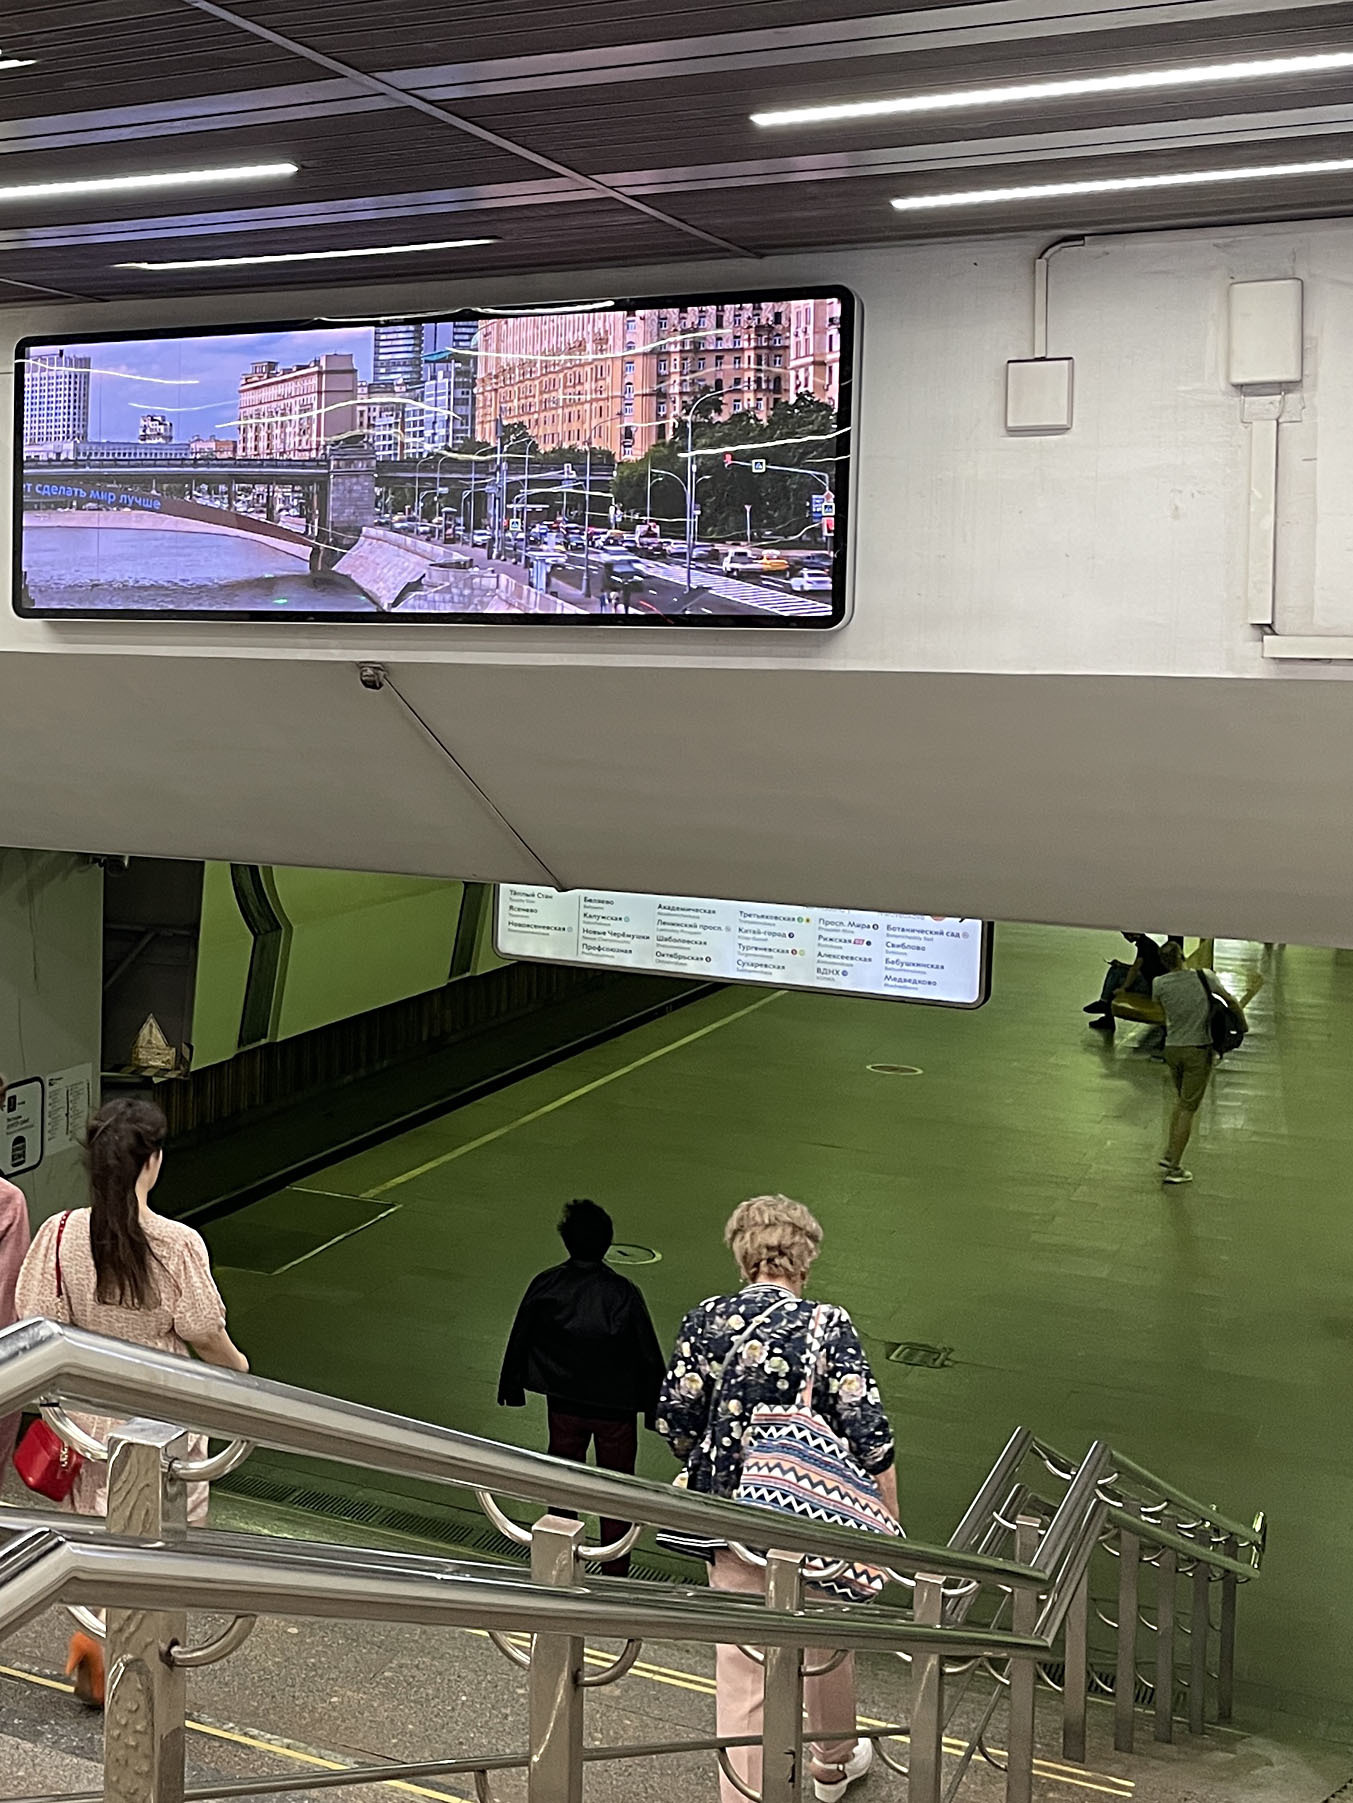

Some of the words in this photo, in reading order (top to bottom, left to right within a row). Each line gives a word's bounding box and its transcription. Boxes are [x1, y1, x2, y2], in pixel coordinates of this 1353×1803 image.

[36, 483, 87, 497] сделать
[90, 490, 116, 504] мир
[120, 495, 161, 510] лучше
[657, 904, 716, 914] Академическая
[583, 913, 622, 922] Калужская
[739, 911, 796, 922] Третьяковская
[848, 921, 871, 930] Мира
[886, 924, 944, 937] Ботанический
[818, 935, 852, 944] Рижская
[886, 941, 926, 951] Свиблово
[817, 952, 872, 963] Алексеевская
[817, 968, 840, 977] ВДНХ
[884, 975, 937, 986] Медведково
